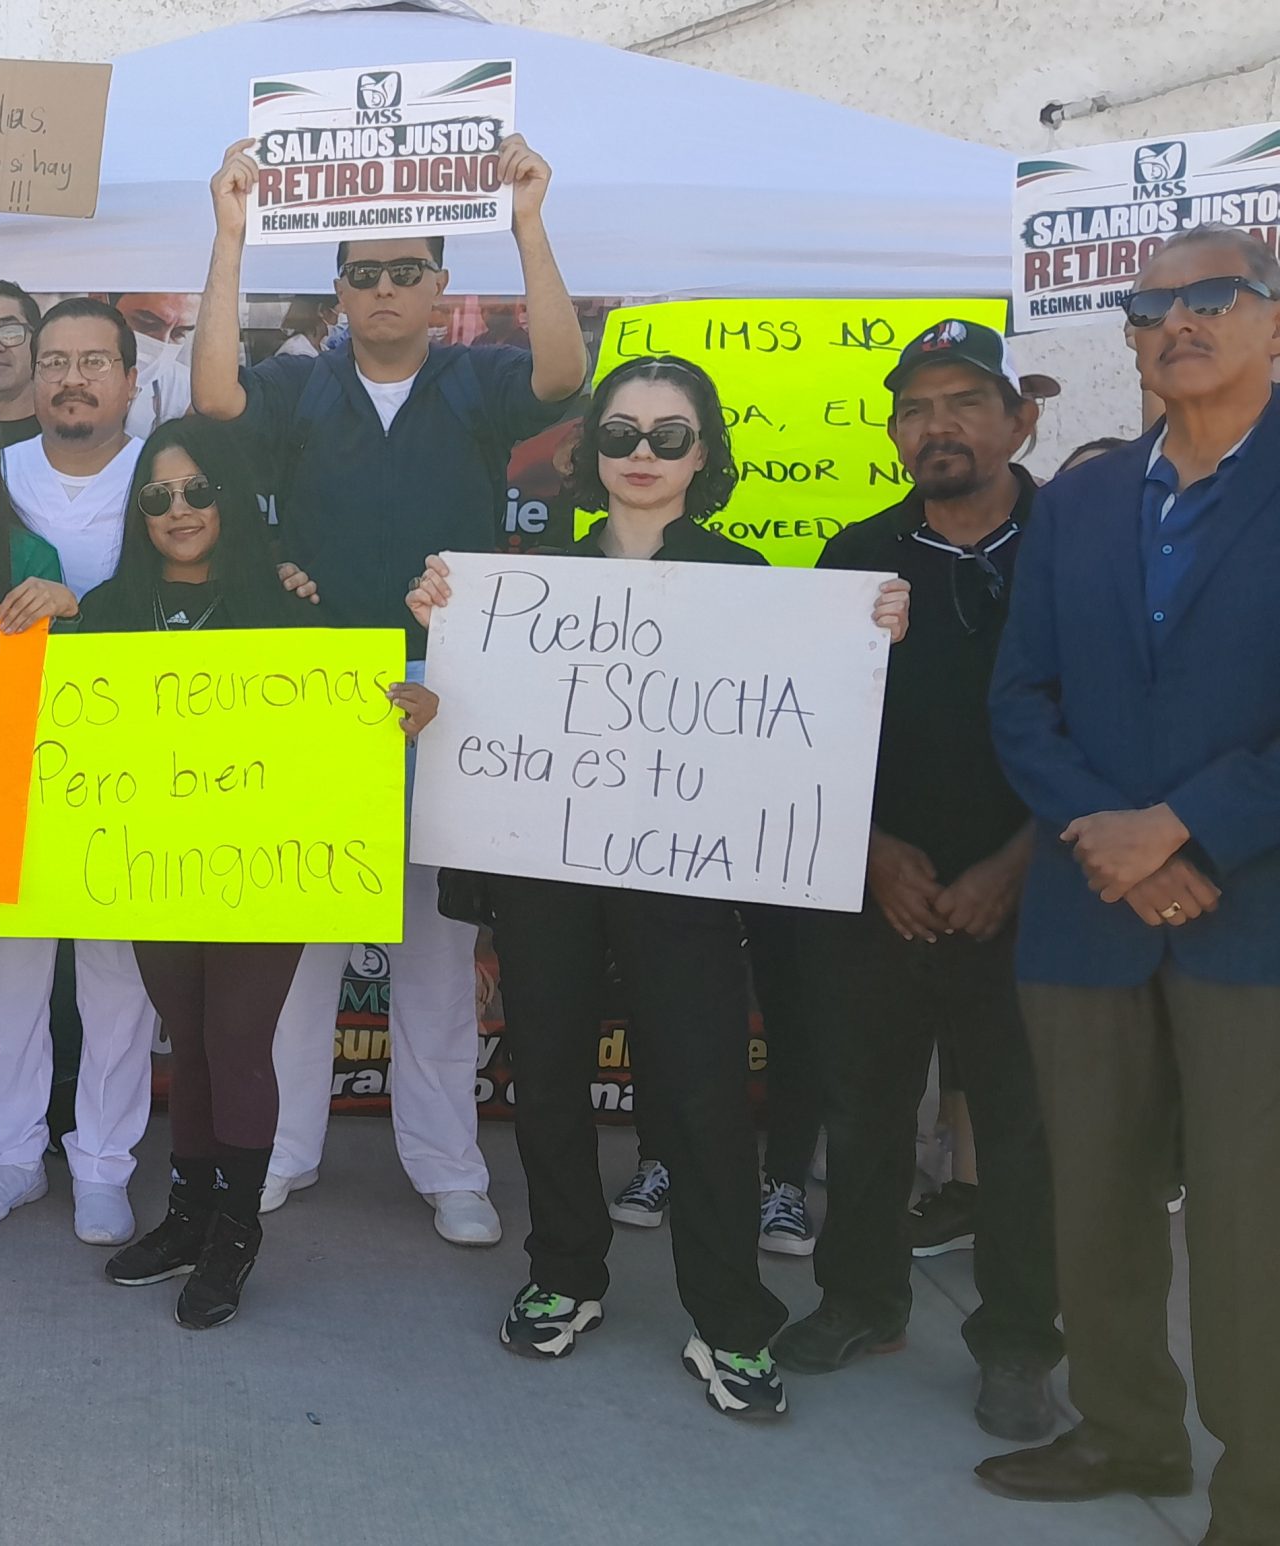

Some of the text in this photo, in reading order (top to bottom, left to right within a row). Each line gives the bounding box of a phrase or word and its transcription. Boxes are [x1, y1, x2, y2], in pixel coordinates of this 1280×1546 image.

[355, 108, 402, 125] IMSS
[267, 119, 496, 165] SALARIOS JUSTOS
[33, 149, 72, 191] hay
[258, 154, 502, 207] RETIRO DIGNO
[1133, 180, 1187, 200] IMSS
[262, 202, 497, 231] RÉGIMEN JUBILACIONES Y PENSIONES
[1033, 190, 1280, 247] SALARIOS JUSTO
[1030, 292, 1092, 316] RÉGIMEN
[617, 318, 895, 357] EL IMSS NO
[720, 398, 886, 432] DA, EL
[740, 459, 839, 483] ADOR
[481, 571, 662, 656] Pueblo
[37, 668, 393, 728] os neuronas
[558, 663, 814, 748] ESCUCHA
[33, 740, 265, 807] Pero bien
[458, 734, 704, 801] esta es tu
[85, 825, 382, 908] Chingonas
